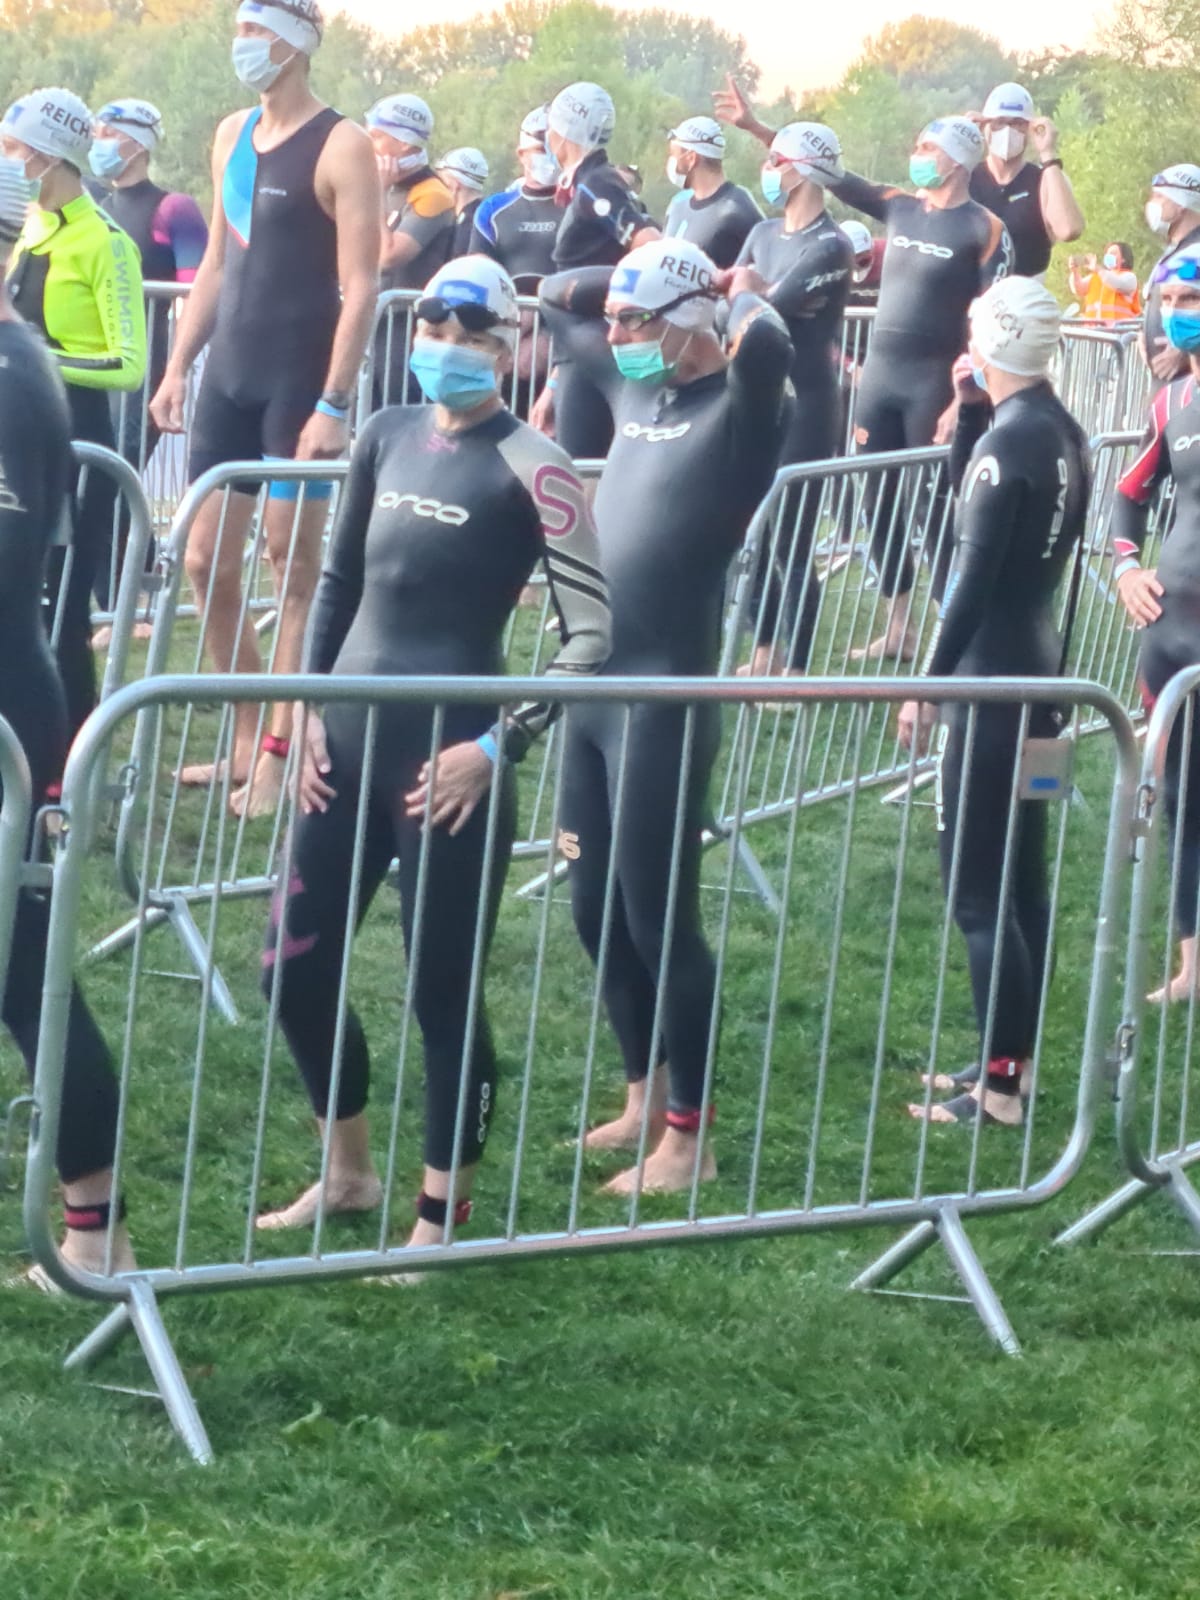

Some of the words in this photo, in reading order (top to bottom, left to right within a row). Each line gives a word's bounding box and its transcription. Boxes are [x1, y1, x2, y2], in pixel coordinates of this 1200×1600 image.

[40, 101, 91, 139] REICH
[952, 122, 982, 145] REIC
[892, 235, 954, 259] orca
[623, 421, 692, 443] orca
[377, 490, 470, 526] orca
[533, 463, 598, 538] S
[1042, 457, 1068, 559] HEAD
[477, 1082, 490, 1144] orca
